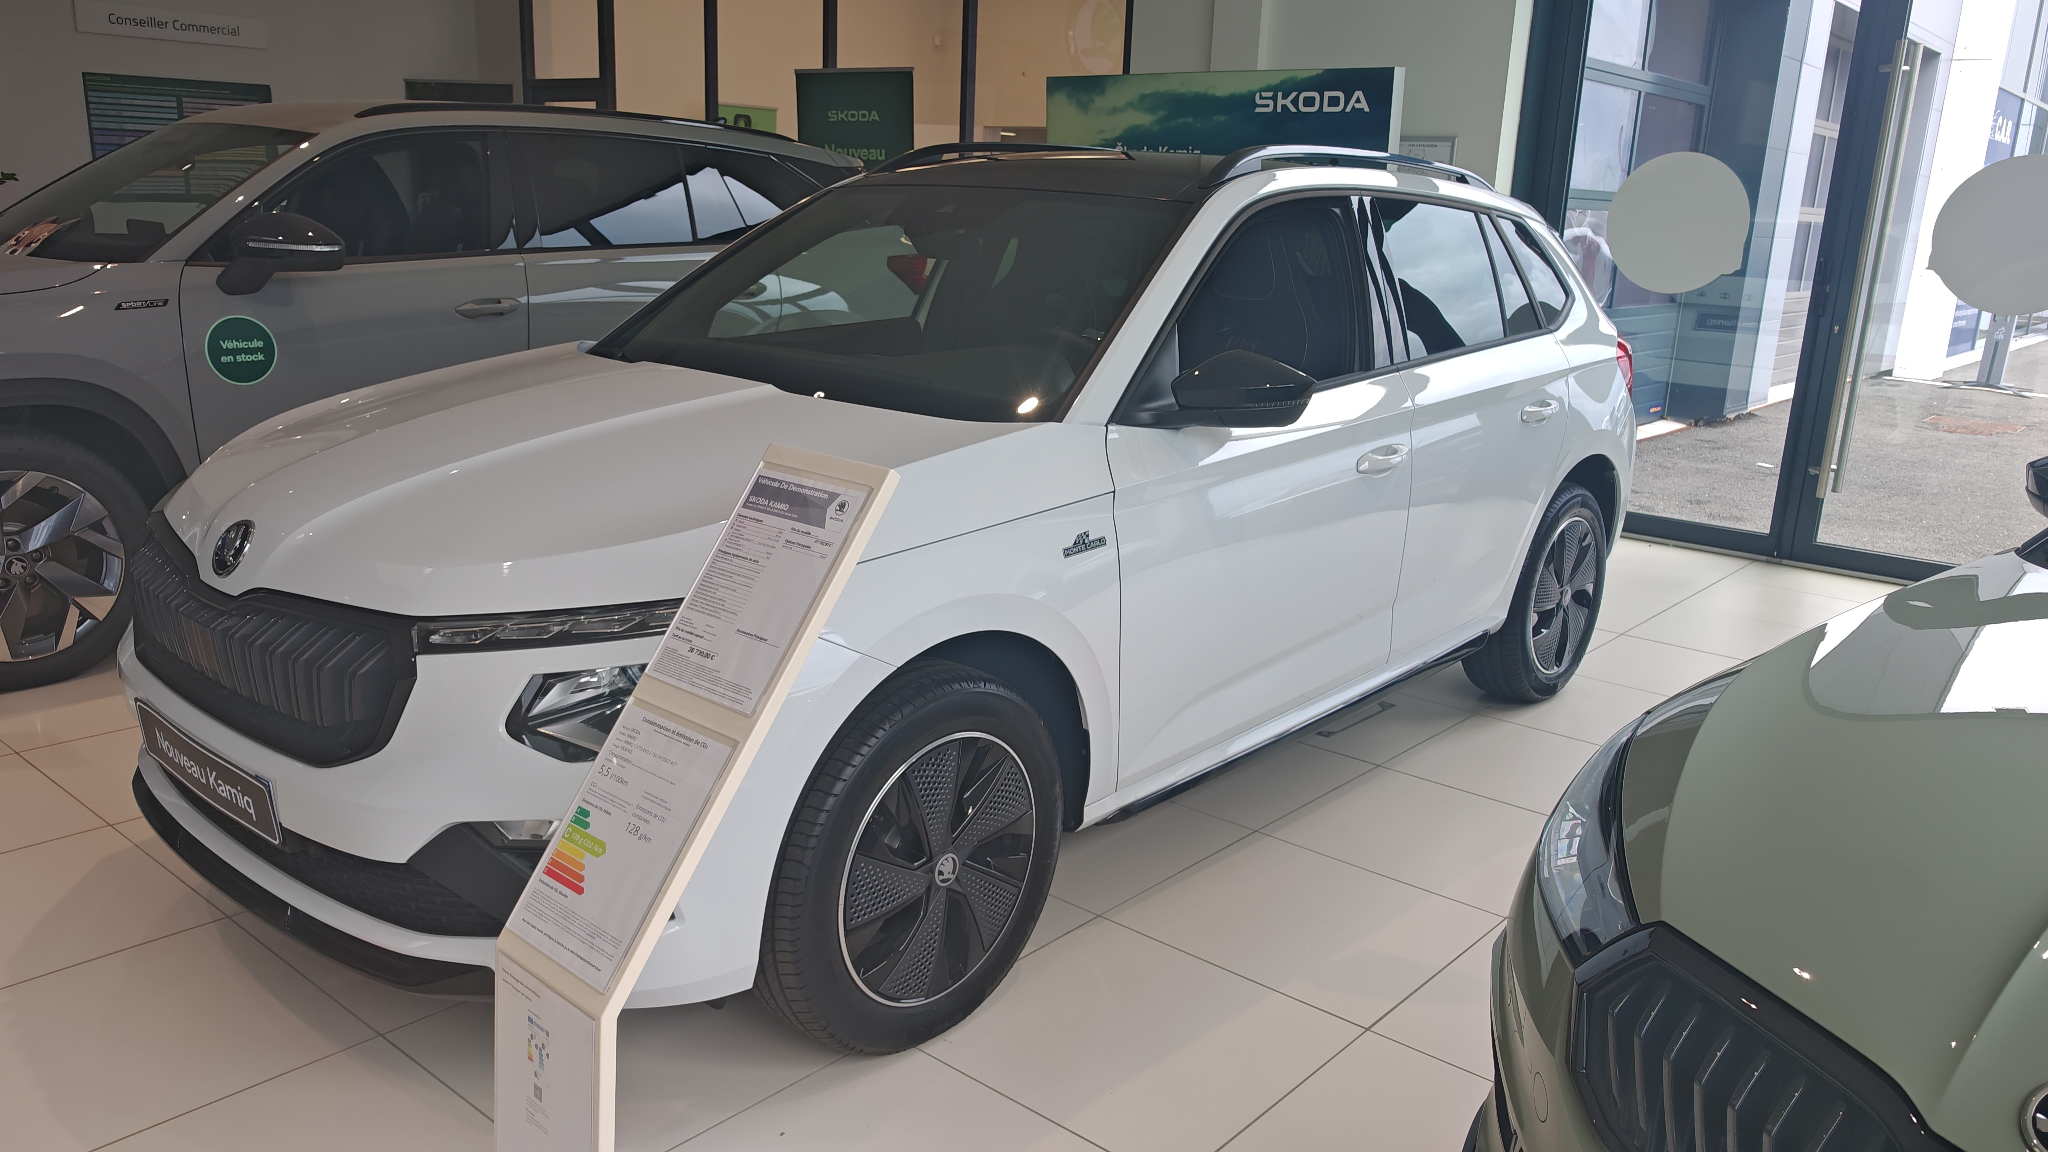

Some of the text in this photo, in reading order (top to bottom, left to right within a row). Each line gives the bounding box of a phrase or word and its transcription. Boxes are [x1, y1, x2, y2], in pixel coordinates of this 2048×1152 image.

[108, 13, 240, 37] Conseiller Commercial
[1254, 90, 1370, 113] SKODA
[828, 110, 880, 122] SKODA
[219, 338, 264, 350] Véhicule
[221, 351, 265, 363] en stock
[758, 477, 829, 500] Véhicule De Démonstration
[748, 495, 769, 506] SKODA
[769, 498, 790, 511] KAMIQ
[1064, 538, 1106, 556] MONTE CARLO
[693, 738, 700, 746] de
[155, 726, 257, 822] Nouveau Kamiq
[597, 764, 612, 777] 5,5
[564, 827, 572, 838] C
[571, 832, 581, 842] 128
[625, 821, 653, 844] 128 g/km
